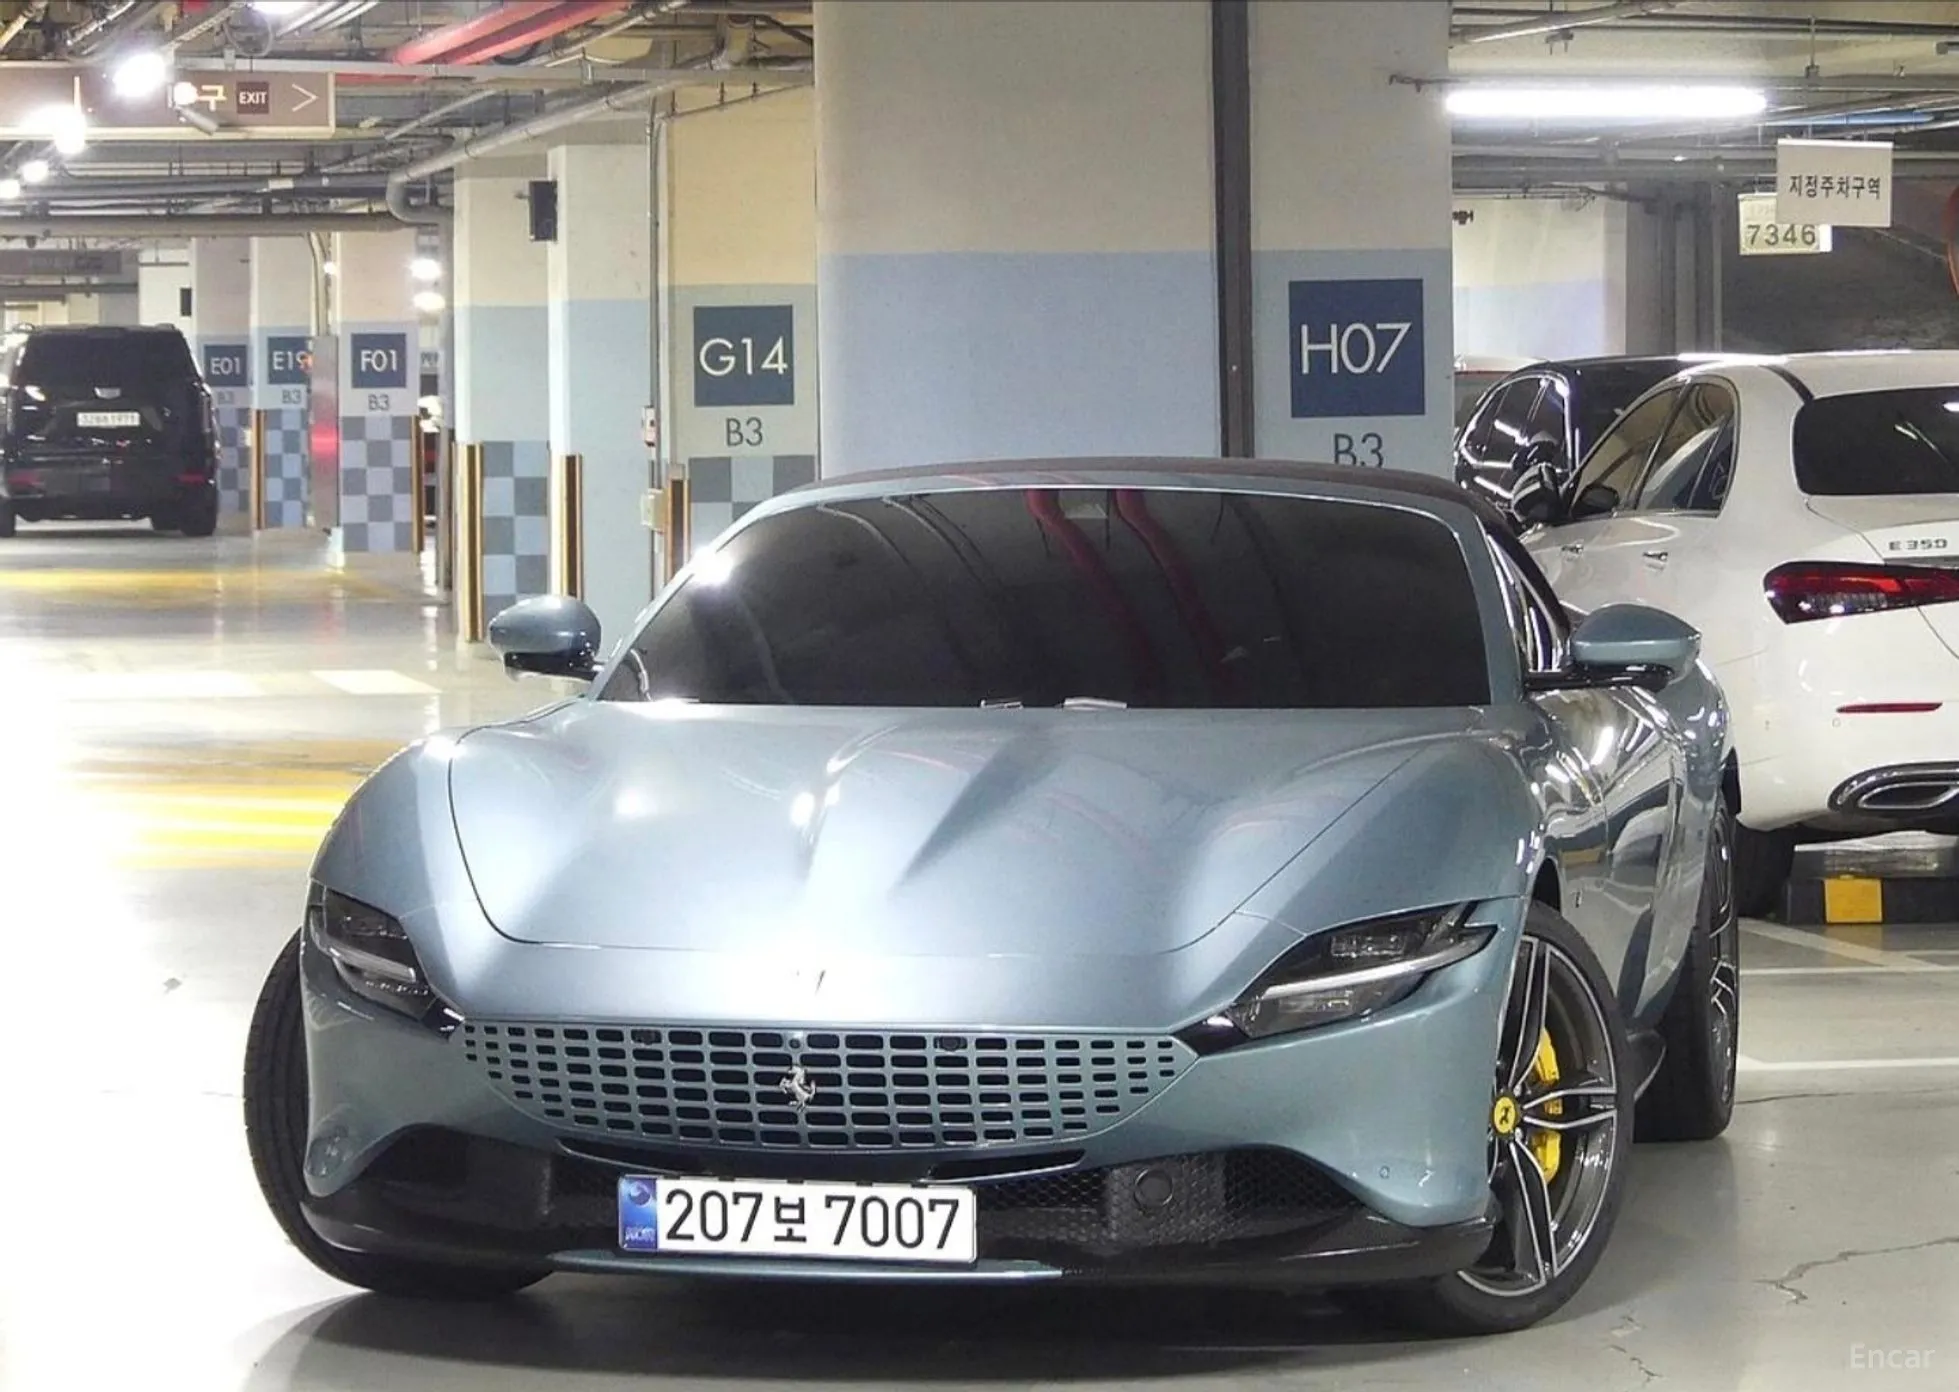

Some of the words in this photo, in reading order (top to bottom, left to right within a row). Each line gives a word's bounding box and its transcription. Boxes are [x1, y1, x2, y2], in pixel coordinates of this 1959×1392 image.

[239, 91, 267, 104] EXIT
[1789, 174, 1881, 199] 지정주차구역
[1747, 224, 1816, 246] 7346
[360, 349, 397, 372] F01
[699, 336, 788, 377] G14
[1301, 322, 1412, 375] H07
[210, 357, 241, 375] E01
[368, 394, 389, 411] B3
[726, 416, 763, 447] B3
[1333, 432, 1384, 468] B3
[1889, 541, 1902, 550] E
[1906, 539, 1948, 550] 350
[665, 1188, 808, 1244] 207보
[824, 1194, 960, 1249] 7007
